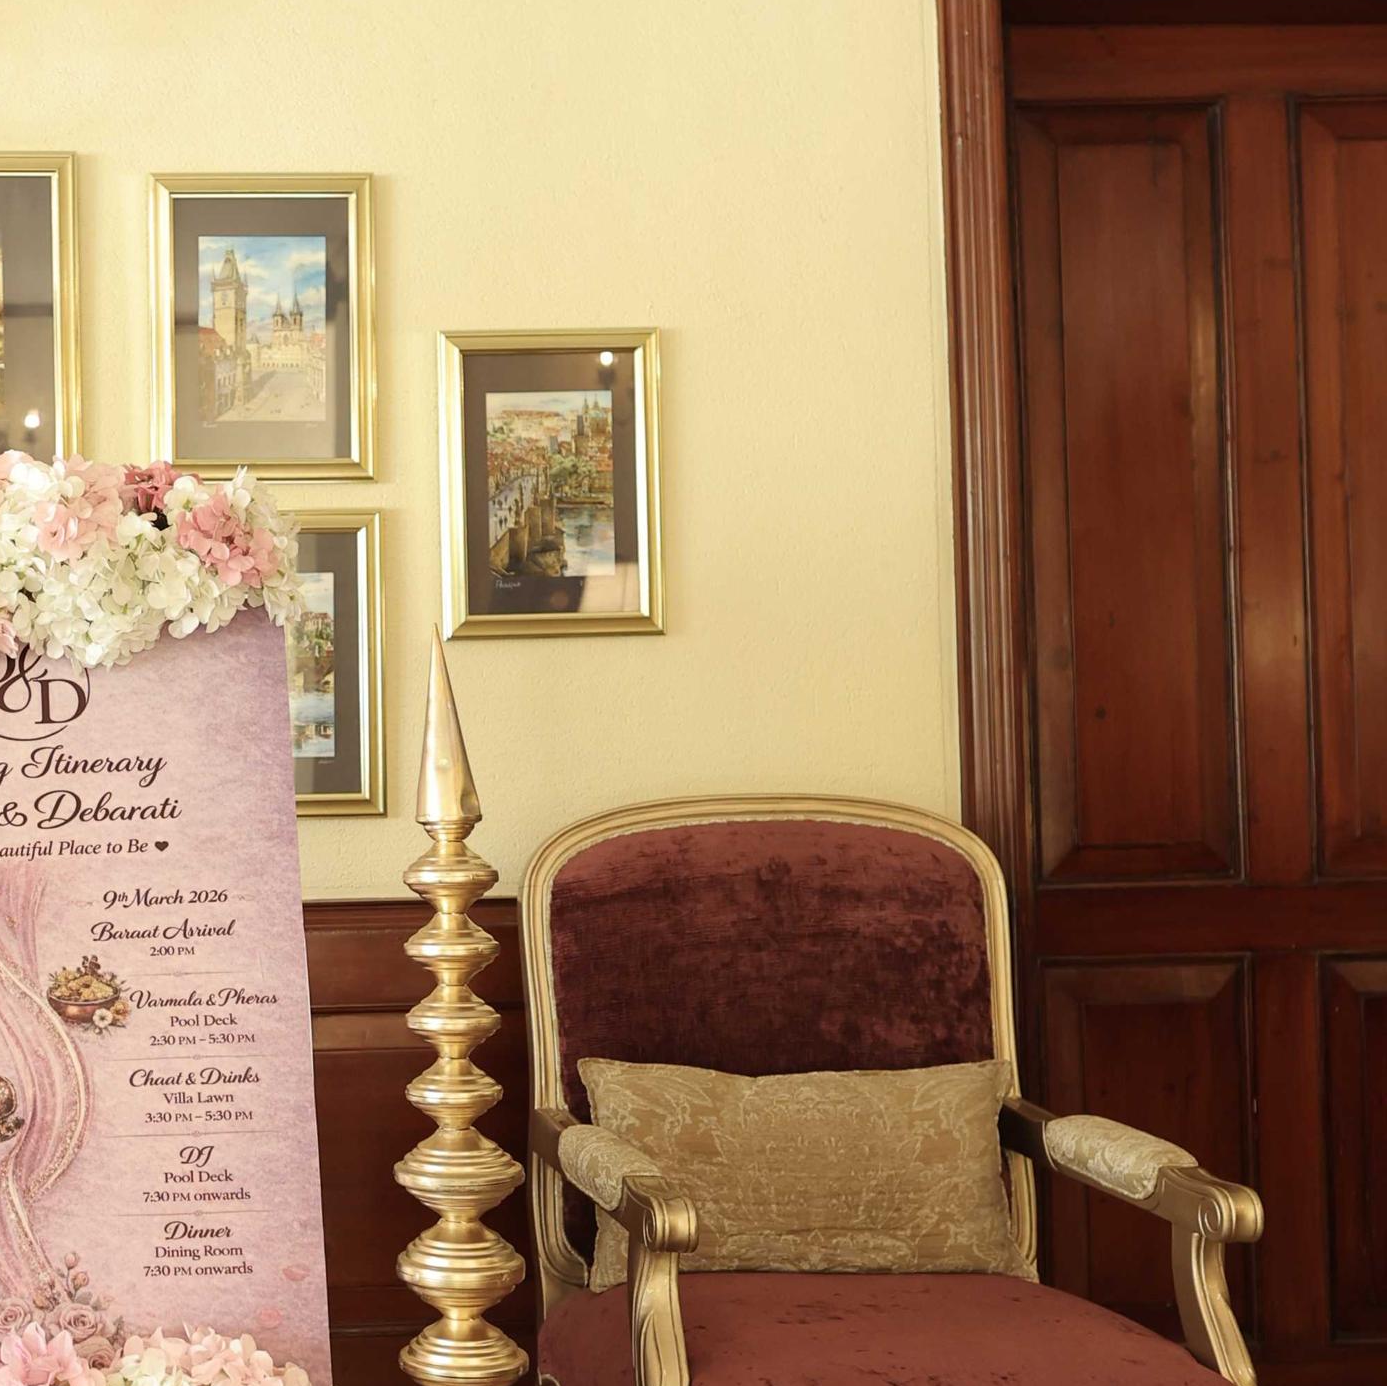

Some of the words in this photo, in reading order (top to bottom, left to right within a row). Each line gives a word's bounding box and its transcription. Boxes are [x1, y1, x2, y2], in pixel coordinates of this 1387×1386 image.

[20, 743, 169, 789] Itinerary
[33, 788, 183, 830] Debarati
[58, 839, 102, 856] Place
[106, 840, 124, 855] to
[126, 838, 149, 854] Be
[121, 887, 184, 909] March
[187, 888, 229, 904] 2026
[90, 921, 161, 942] Baraat
[149, 945, 175, 957] 2:00
[176, 946, 196, 956] PM
[129, 989, 203, 1010] Varmala
[205, 992, 217, 1007] &
[217, 986, 279, 1007] Pheras
[169, 1014, 200, 1028] Pool
[203, 1013, 238, 1026] Deck
[149, 1034, 176, 1047] 2:30
[178, 1035, 197, 1045] PM
[208, 1033, 235, 1044] 5:30
[237, 1033, 256, 1044] PM
[128, 1068, 183, 1088] Chaat
[184, 1072, 197, 1086] &
[199, 1066, 261, 1086] Drinks
[163, 1092, 193, 1105] Villa
[196, 1091, 235, 1104] Lawn
[144, 1111, 172, 1124] 3:30
[174, 1112, 193, 1122] PM
[204, 1110, 232, 1122] 5:30
[234, 1110, 254, 1121] PM
[179, 1145, 215, 1168] DJ
[163, 1170, 195, 1184] Pool
[198, 1169, 235, 1183] Deck
[142, 1191, 170, 1204] 7:30
[172, 1192, 192, 1202] PM
[193, 1187, 252, 1202] onwards
[163, 1220, 234, 1241] Dinner
[154, 1246, 201, 1261] Dining
[203, 1245, 244, 1257] Room
[143, 1265, 171, 1278] 7:30
[173, 1266, 192, 1277] PM
[194, 1261, 254, 1276] onwards
